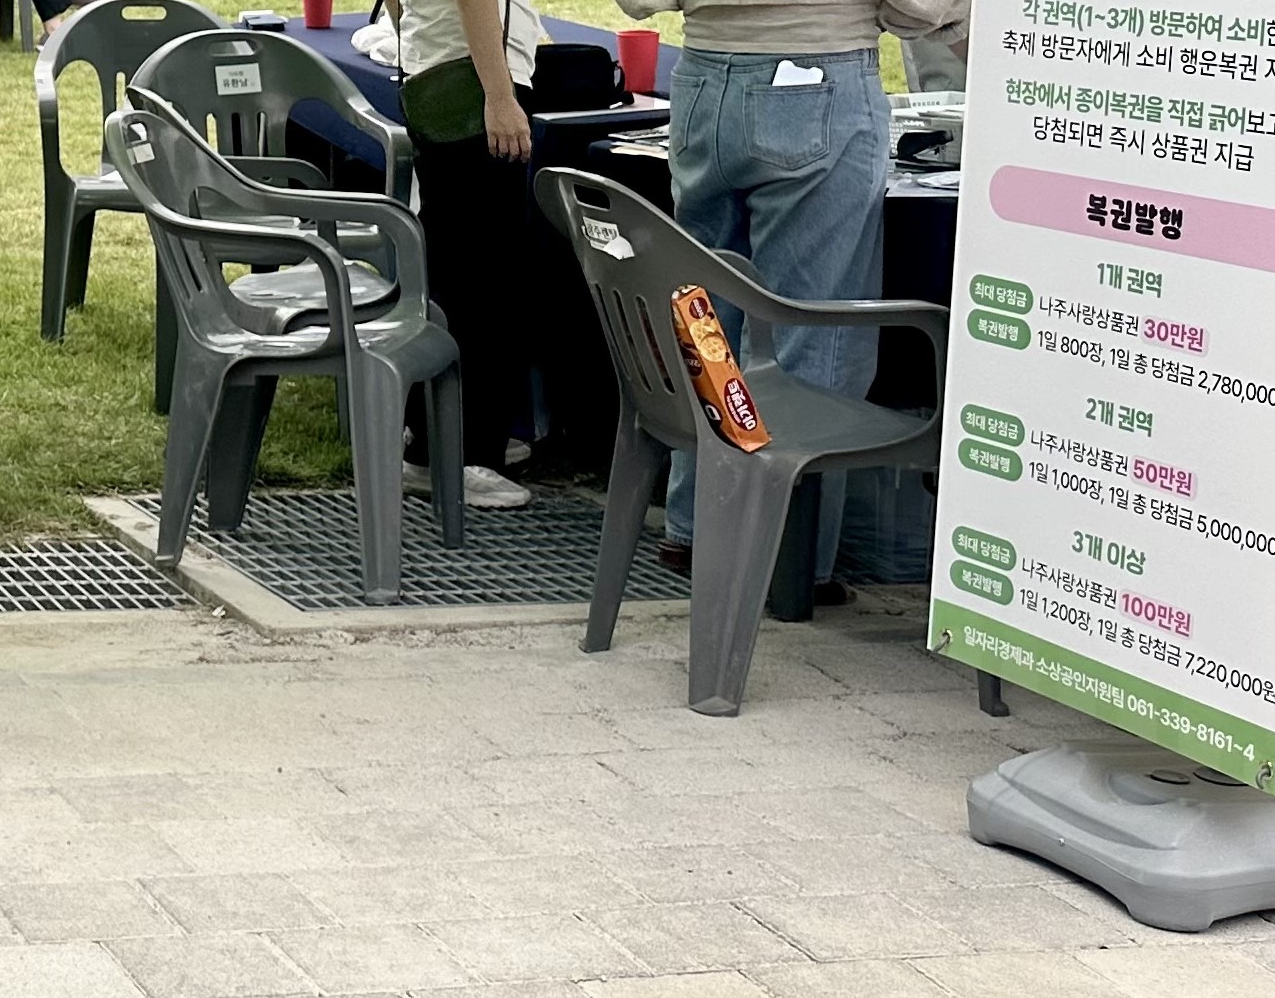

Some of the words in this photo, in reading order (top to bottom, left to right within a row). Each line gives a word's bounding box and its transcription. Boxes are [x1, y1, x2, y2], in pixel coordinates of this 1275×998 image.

[1042, 0, 1144, 37] 권역(1~3개)
[1149, 9, 1223, 42] 방문하여
[1001, 30, 1036, 56] 축제
[1041, 34, 1131, 68] 방문자에게
[1135, 44, 1174, 73] 소비
[1180, 48, 1258, 82] 행운복권
[1005, 78, 1071, 111] 현장에서
[1074, 87, 1163, 123] 종이복권을
[1168, 98, 1204, 128] 직접
[1033, 116, 1104, 149] 당첨되면
[1109, 125, 1146, 155] 즉시
[1152, 133, 1209, 165] 상품권
[1214, 142, 1255, 172] 지급
[1086, 194, 1184, 240] 복권발행
[974, 282, 995, 300] 최대
[996, 287, 1027, 309] 당첨금
[1097, 263, 1123, 290] 1개
[1126, 271, 1163, 298] 권역
[977, 318, 1019, 342] 복권발행
[1039, 296, 1140, 338] 나주사랑상품권
[1144, 318, 1204, 353] 30만원
[1037, 330, 1057, 352] 1일
[1060, 338, 1106, 366] 800장,
[1110, 349, 1130, 371] 1일
[1133, 354, 1148, 375] 총
[1152, 358, 1195, 387] 당첨금
[965, 411, 986, 431] 최대
[987, 417, 1019, 440] 당첨금
[1085, 397, 1114, 427] 2개
[1117, 406, 1153, 437] 권역
[968, 447, 1011, 473] 복권발행
[1030, 430, 1129, 477] 나주사랑상품권
[1132, 459, 1193, 497] 50만원
[1028, 461, 1049, 485] 1일
[1051, 468, 1105, 504] 1,000장,
[1108, 487, 1130, 510] 1일
[1132, 494, 1147, 515] 총
[1150, 499, 1193, 531] 당첨금
[957, 533, 979, 554] 최대
[980, 540, 1012, 564] 당첨금
[1071, 530, 1103, 562] 3개
[1107, 540, 1147, 576] 이상
[962, 570, 1003, 596] 복권발행
[1022, 558, 1118, 610] 나주사랑상품권
[1121, 592, 1192, 637] 100만원
[1019, 588, 1039, 612] 1일
[1041, 597, 1094, 635] 1,200장,
[1097, 618, 1117, 642] 1일
[1120, 627, 1135, 650] 총
[1138, 633, 1183, 668] 당첨금
[963, 626, 1034, 671] 일자리경제과
[1036, 658, 1125, 710] 소상공인지원팀
[1127, 695, 1255, 762] 061-339-8161~4
